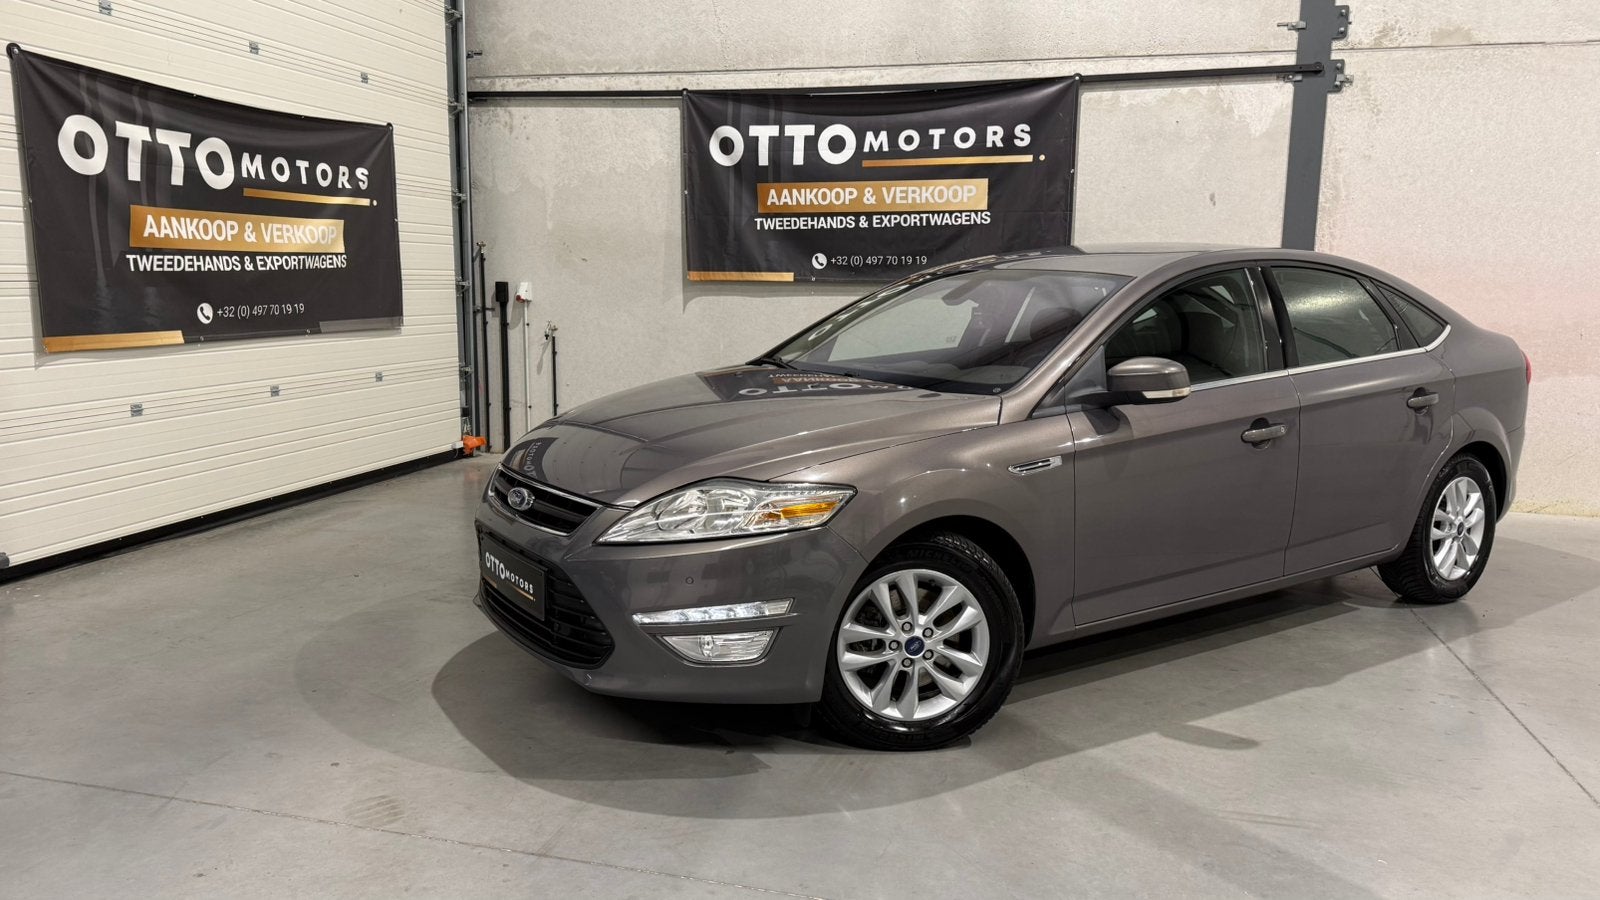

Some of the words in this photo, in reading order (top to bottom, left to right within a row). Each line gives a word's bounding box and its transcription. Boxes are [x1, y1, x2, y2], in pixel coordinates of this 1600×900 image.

[57, 114, 235, 190] OTTO
[241, 152, 370, 190] MOTORS
[708, 123, 857, 167] OTTO
[863, 123, 1032, 153] MOTORS
[767, 187, 858, 206] AANKOOP
[863, 186, 876, 205] &
[881, 185, 977, 204] VERKOOP
[143, 214, 239, 242] AANKOOP
[243, 221, 257, 243] &
[260, 222, 337, 245] VERKOOP
[754, 216, 856, 231] TWEEDEHANDS
[859, 215, 869, 228] &
[872, 211, 991, 228] EXPORTWAGENS
[126, 254, 242, 272] TWEEDEHANDS
[244, 256, 254, 271] &
[256, 254, 348, 271] EXPORTWAGENS
[830, 256, 848, 266] +32
[850, 255, 864, 267] (0)
[865, 256, 884, 266] 497
[885, 256, 898, 266] 70
[900, 256, 912, 266] 19
[915, 256, 927, 266] 19
[216, 306, 235, 318] +32
[237, 305, 250, 320] (0)
[252, 305, 268, 316] 497
[269, 304, 280, 315] 70
[281, 304, 292, 315] 19
[294, 303, 305, 314] 19
[485, 551, 506, 580] OTTO
[505, 569, 534, 594] MOTORS
